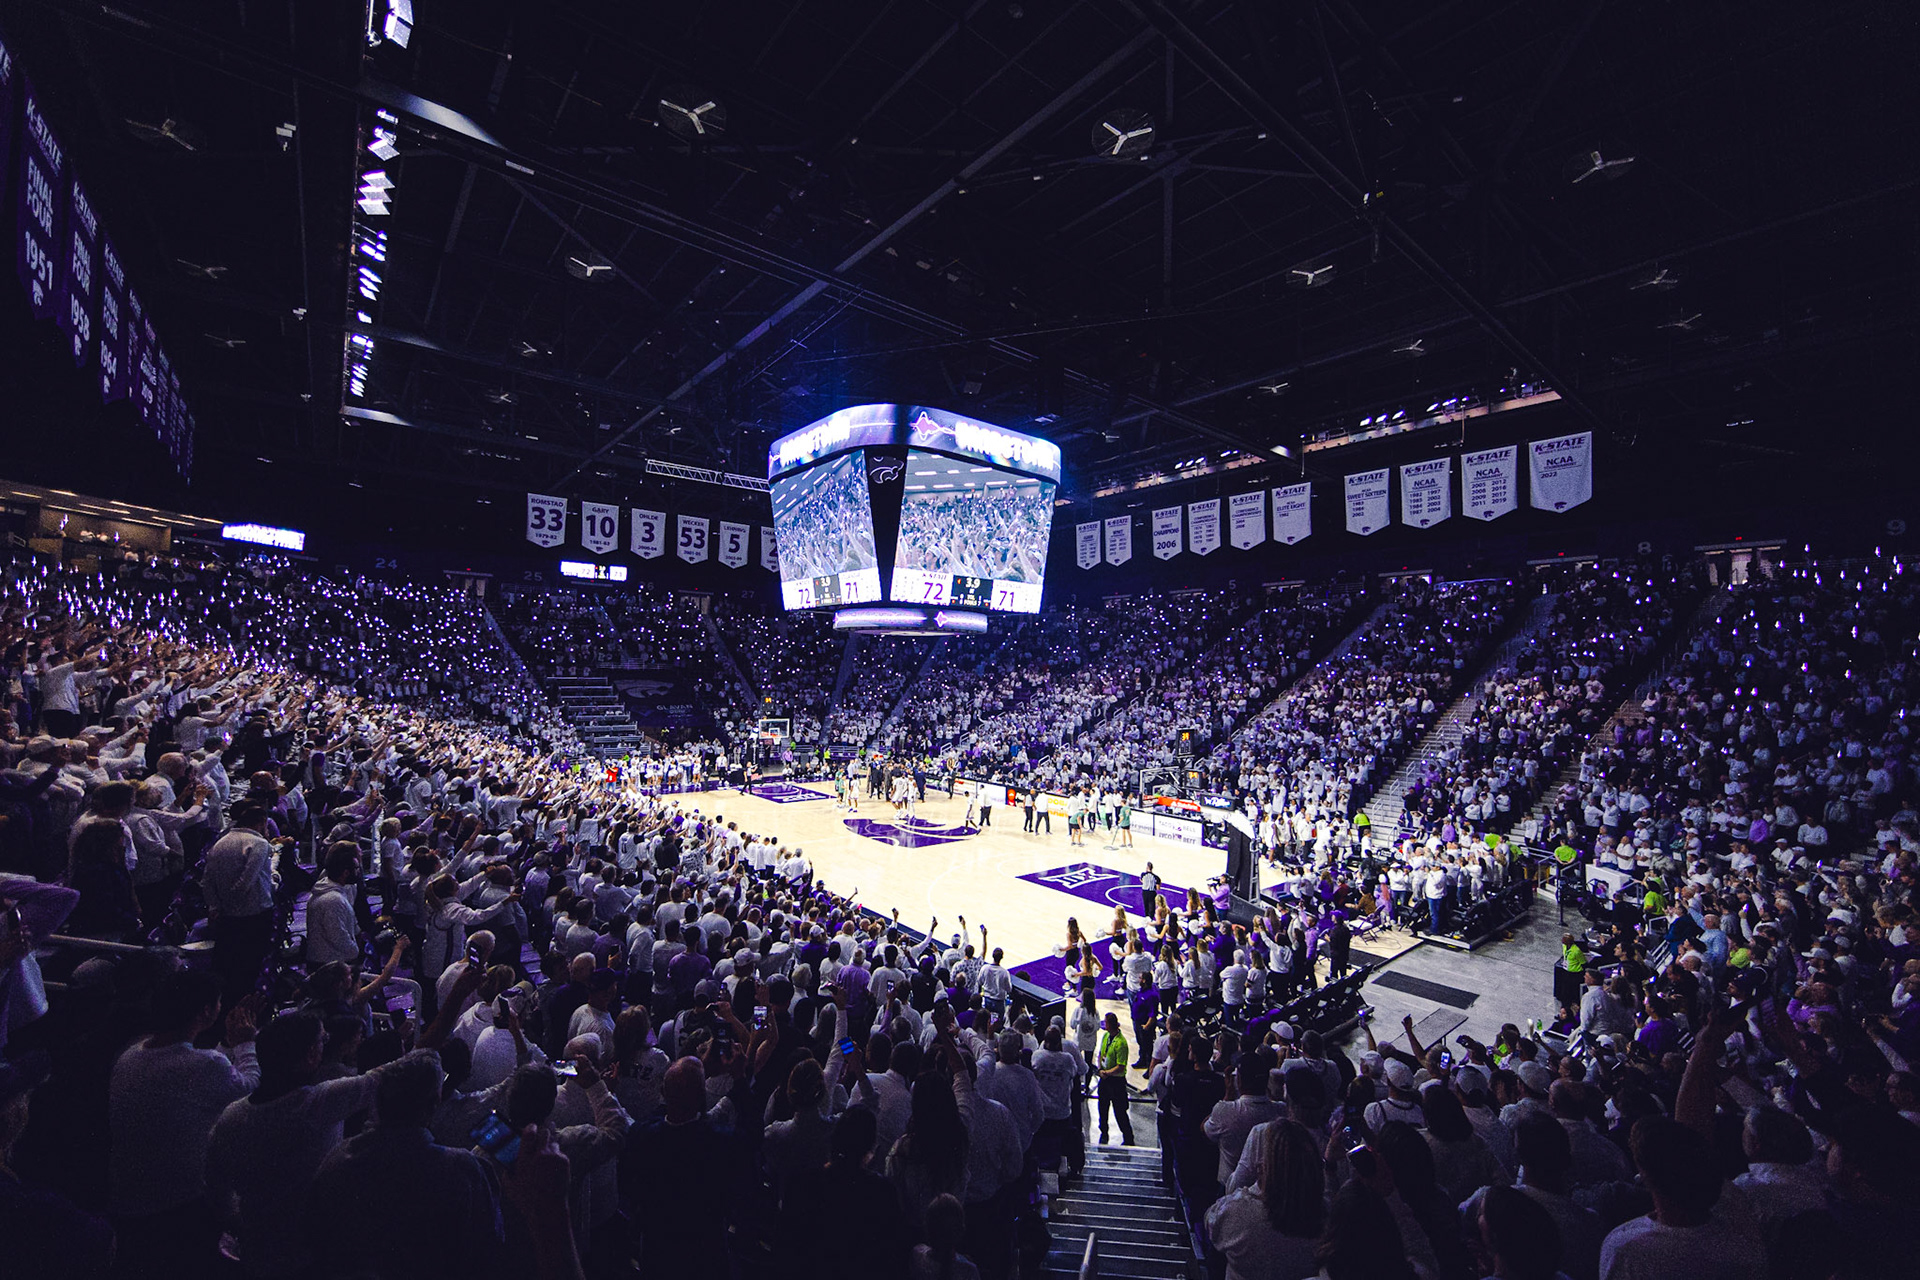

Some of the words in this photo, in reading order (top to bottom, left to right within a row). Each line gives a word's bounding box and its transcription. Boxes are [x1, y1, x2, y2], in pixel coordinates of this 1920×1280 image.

[26, 98, 62, 171] K-STATE
[28, 156, 53, 216] FINAL
[27, 182, 52, 238] FOUR
[25, 230, 53, 290] 1951
[71, 293, 90, 341] 1958
[1535, 436, 1586, 452] K-STATE
[1466, 450, 1511, 464] K-STATE
[1546, 455, 1573, 466] NCAA
[1405, 461, 1446, 475] K-STATE
[1476, 467, 1500, 477] NCAA
[1541, 471, 1557, 479] 2022
[1348, 472, 1385, 485] K-STATE
[1413, 478, 1436, 487] NCAA
[1275, 486, 1305, 497] K-STATE
[1346, 493, 1364, 501] SWEET
[1364, 489, 1387, 498] SIXTEEN
[531, 498, 564, 507] ROMSTAD
[1232, 494, 1261, 504] K-STATE
[1191, 502, 1216, 511] K-STATE
[530, 507, 563, 531] 33
[586, 515, 615, 538] 10
[641, 522, 655, 543] 3
[679, 527, 706, 549] 53
[728, 534, 741, 553] 5
[1156, 540, 1177, 550] 2006
[523, 570, 543, 581] 25
[965, 577, 981, 589] 3.9
[798, 588, 811, 605] 72
[845, 581, 858, 599] 71
[923, 581, 944, 601] 72
[999, 590, 1015, 608] 71
